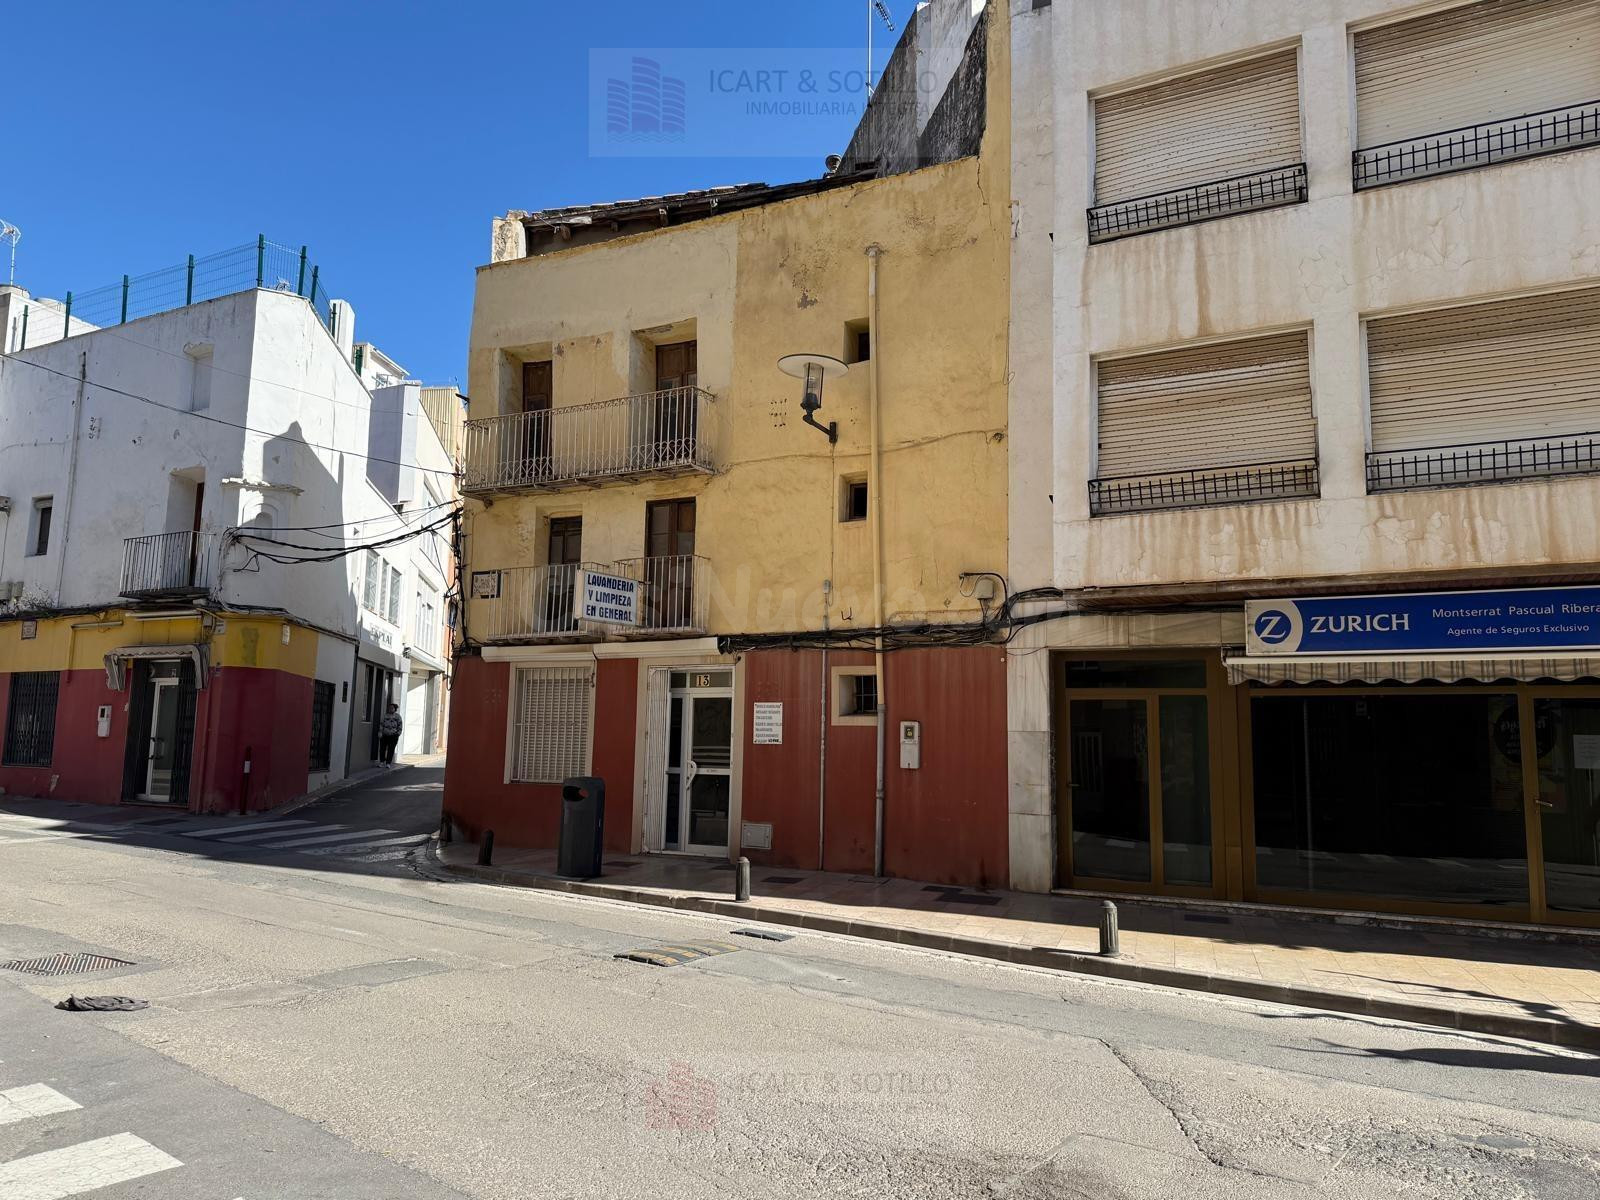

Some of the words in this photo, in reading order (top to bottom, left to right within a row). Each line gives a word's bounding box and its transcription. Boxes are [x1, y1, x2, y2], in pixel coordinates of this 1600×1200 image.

[587, 574, 634, 593] LAVANDERIA
[588, 589, 594, 601] Y
[595, 590, 632, 607] LIMPIEZA
[586, 604, 597, 617] EN
[598, 606, 633, 622] GENERAL
[1432, 607, 1502, 618] Montserrat
[1508, 604, 1554, 616] Pascual
[1310, 613, 1410, 634] ZURICH
[1447, 626, 1483, 637] Agente
[1485, 625, 1498, 635] de
[1500, 624, 1541, 636] Seguros
[1543, 623, 1590, 633] Exclusivo
[697, 675, 709, 687] 13
